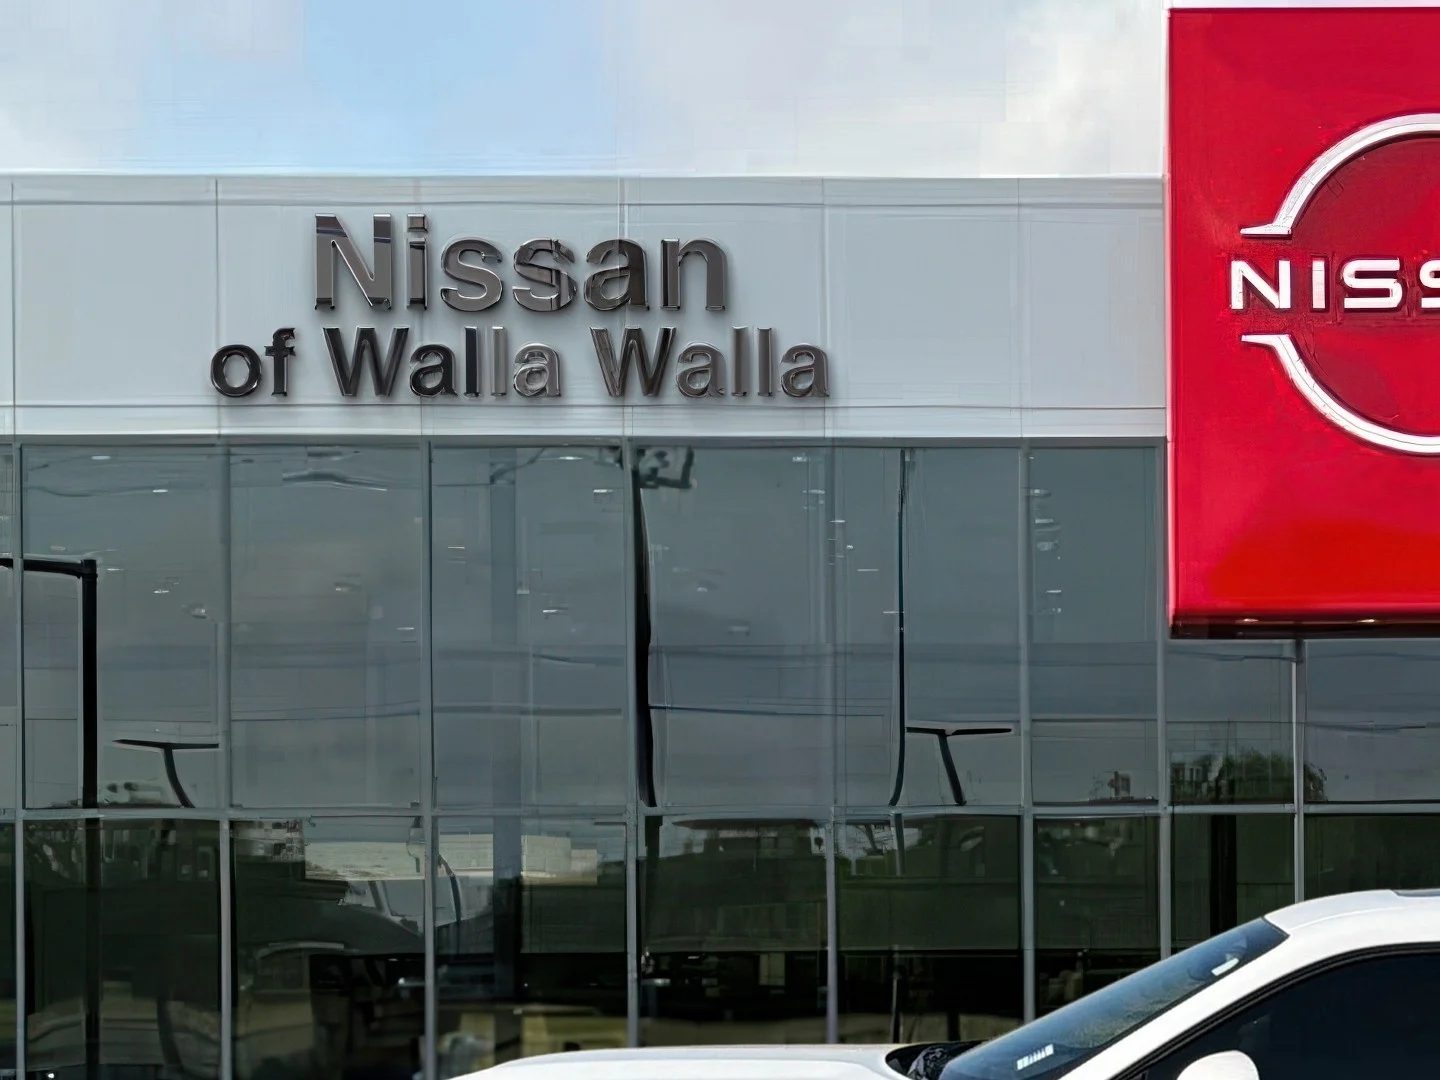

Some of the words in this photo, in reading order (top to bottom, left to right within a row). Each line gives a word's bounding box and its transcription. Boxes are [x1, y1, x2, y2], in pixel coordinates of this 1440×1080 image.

[314, 212, 727, 312] Nissan
[209, 326, 296, 398] of
[322, 325, 562, 398] Walla
[589, 325, 830, 398] Walla
